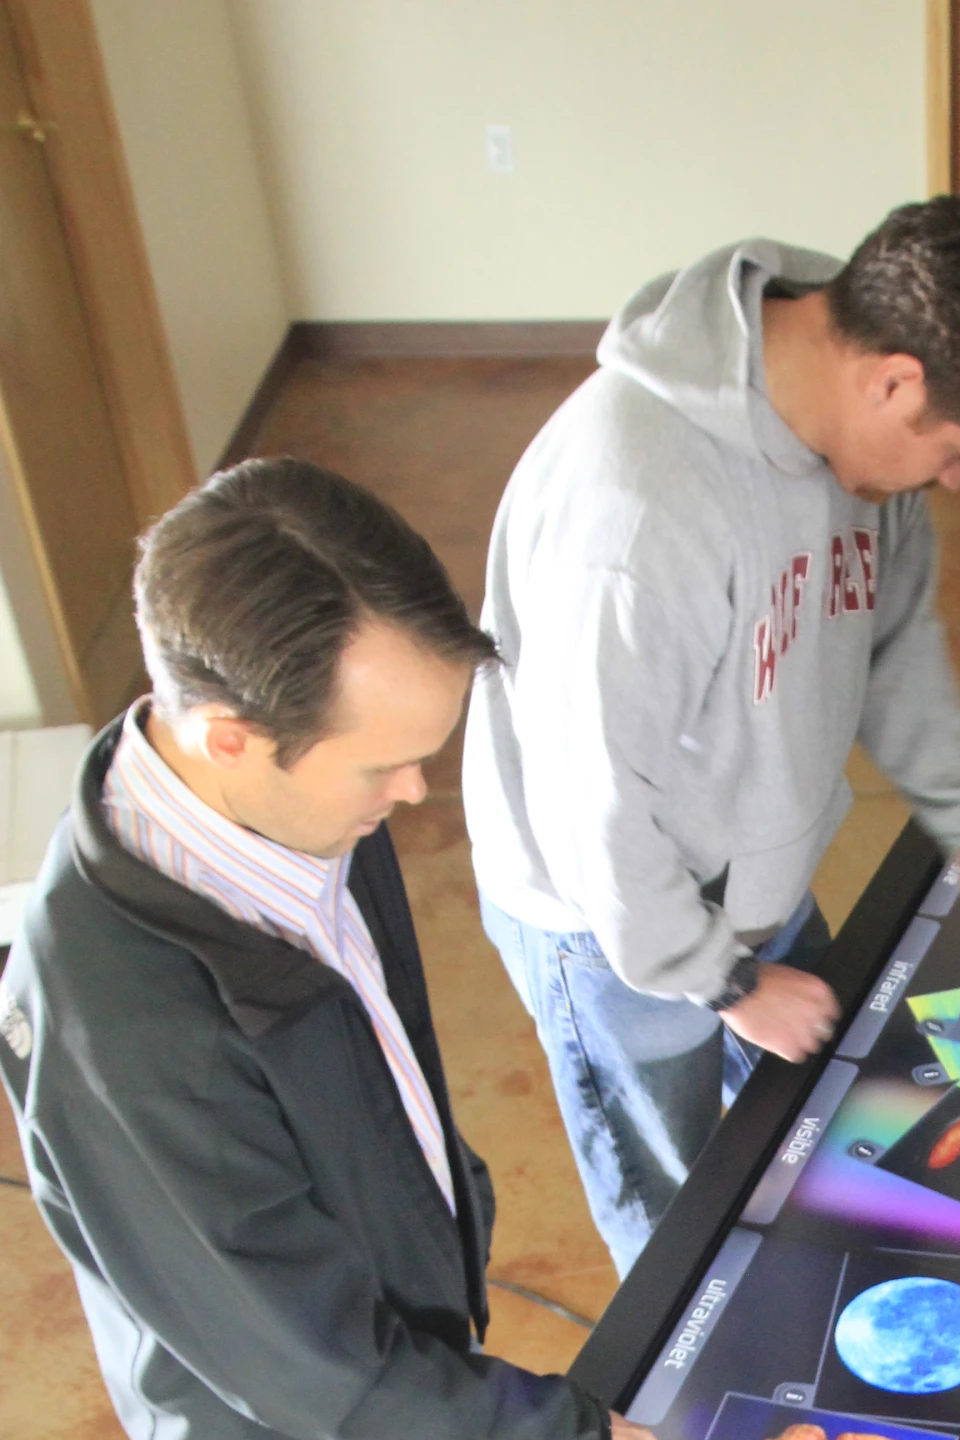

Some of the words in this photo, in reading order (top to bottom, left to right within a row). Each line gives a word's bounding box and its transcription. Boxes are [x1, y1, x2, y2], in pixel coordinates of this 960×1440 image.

[869, 961, 914, 1013] infrared
[781, 1117, 820, 1164] visible
[664, 1279, 727, 1369] ultraviolet
